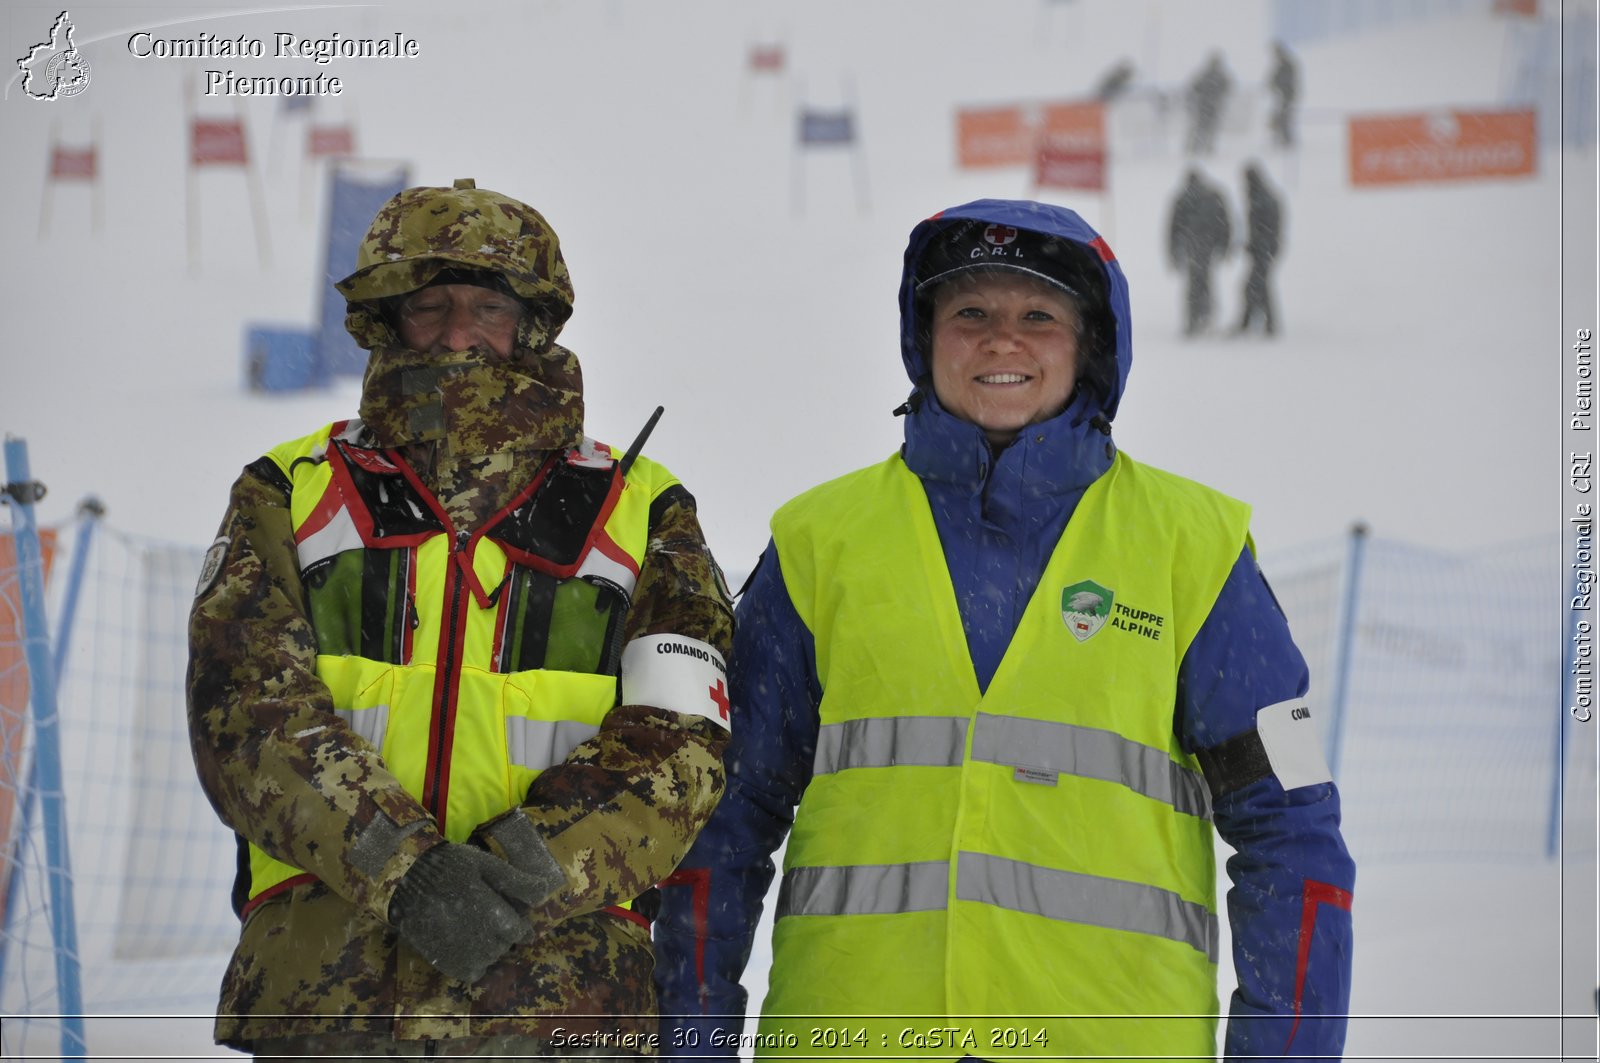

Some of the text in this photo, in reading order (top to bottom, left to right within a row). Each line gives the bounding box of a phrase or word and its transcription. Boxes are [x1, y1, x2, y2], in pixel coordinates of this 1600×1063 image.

[1115, 602, 1164, 627] TRUPPE
[1111, 617, 1161, 641] ALPINE
[656, 642, 709, 663] COMANDO
